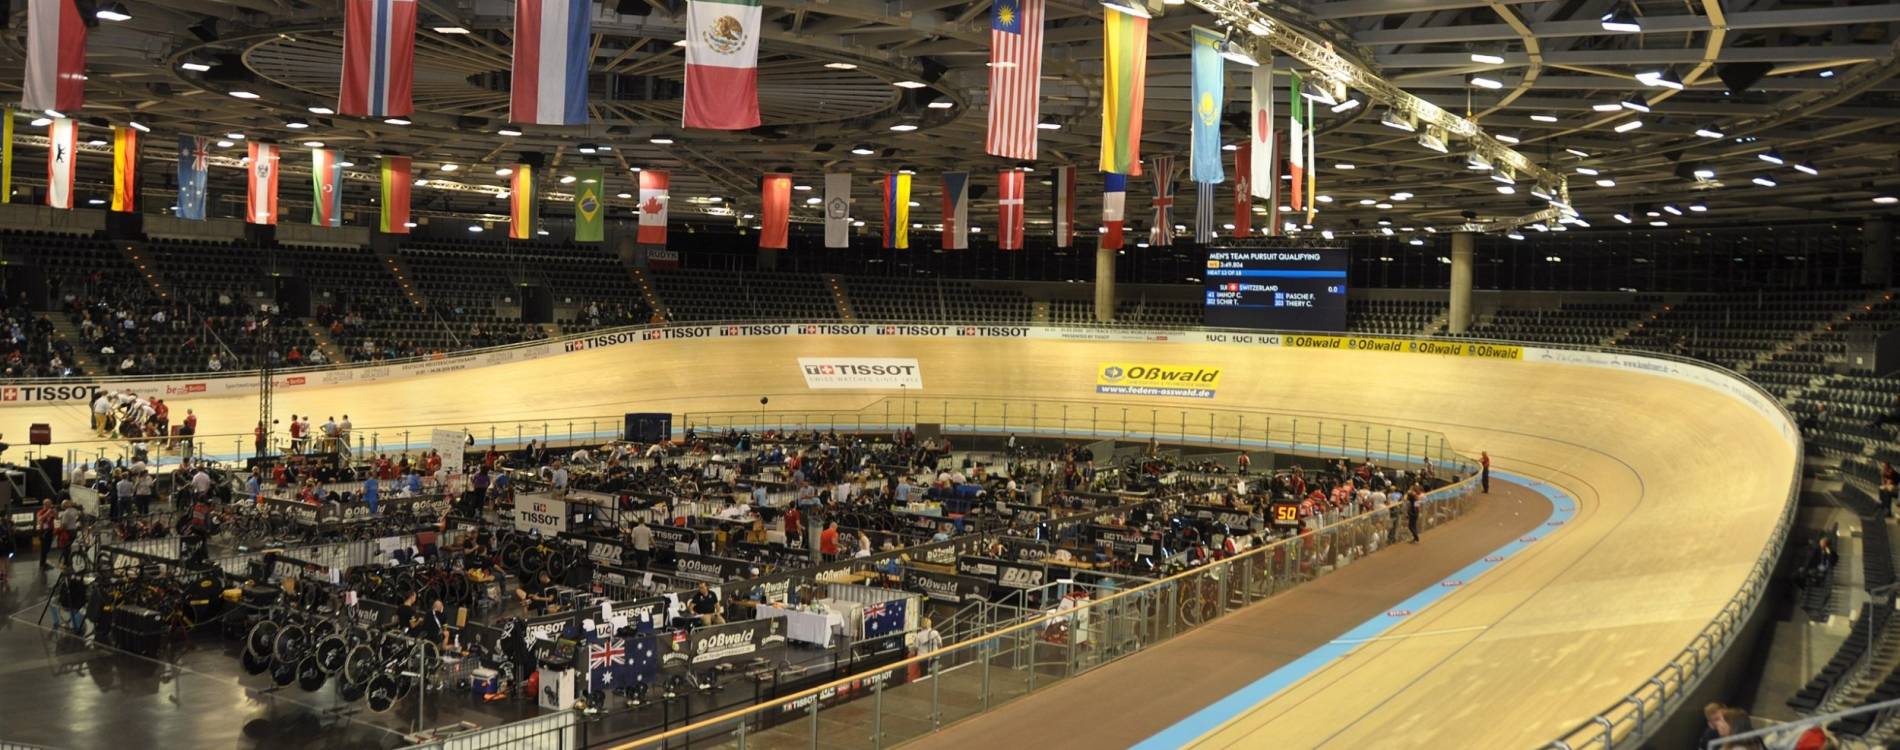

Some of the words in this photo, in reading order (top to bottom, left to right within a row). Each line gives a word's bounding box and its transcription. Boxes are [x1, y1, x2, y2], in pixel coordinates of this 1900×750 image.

[1279, 253, 1320, 261] QUALIFYING
[1239, 284, 1279, 292] SWITZERLAND
[662, 327, 712, 339] TISSOT
[740, 324, 790, 336] TISSOT
[819, 325, 869, 335] TISSOT
[898, 326, 949, 337] TISSOT
[979, 328, 1030, 337] TISSOT
[585, 332, 636, 349] TISSOT
[1296, 337, 1341, 349] Oßwald
[1359, 339, 1402, 352] Oßwald
[1419, 342, 1462, 356] Oßwald
[1478, 345, 1518, 359] Oßwald
[834, 365, 915, 375] TISSOT
[1127, 366, 1220, 383] Oßwald
[21, 386, 101, 401] TISSOT
[1101, 386, 1210, 397] www.federn-osswald.de
[521, 511, 560, 526] TISSOT
[1278, 506, 1297, 520] 50
[657, 530, 682, 541] TISSOT
[591, 542, 623, 560] BDR
[687, 561, 722, 575] Oßwald
[822, 567, 851, 582] Oßwald
[1003, 567, 1043, 586] BDR
[918, 577, 958, 592] Oßwald
[707, 629, 755, 648] Oßwald
